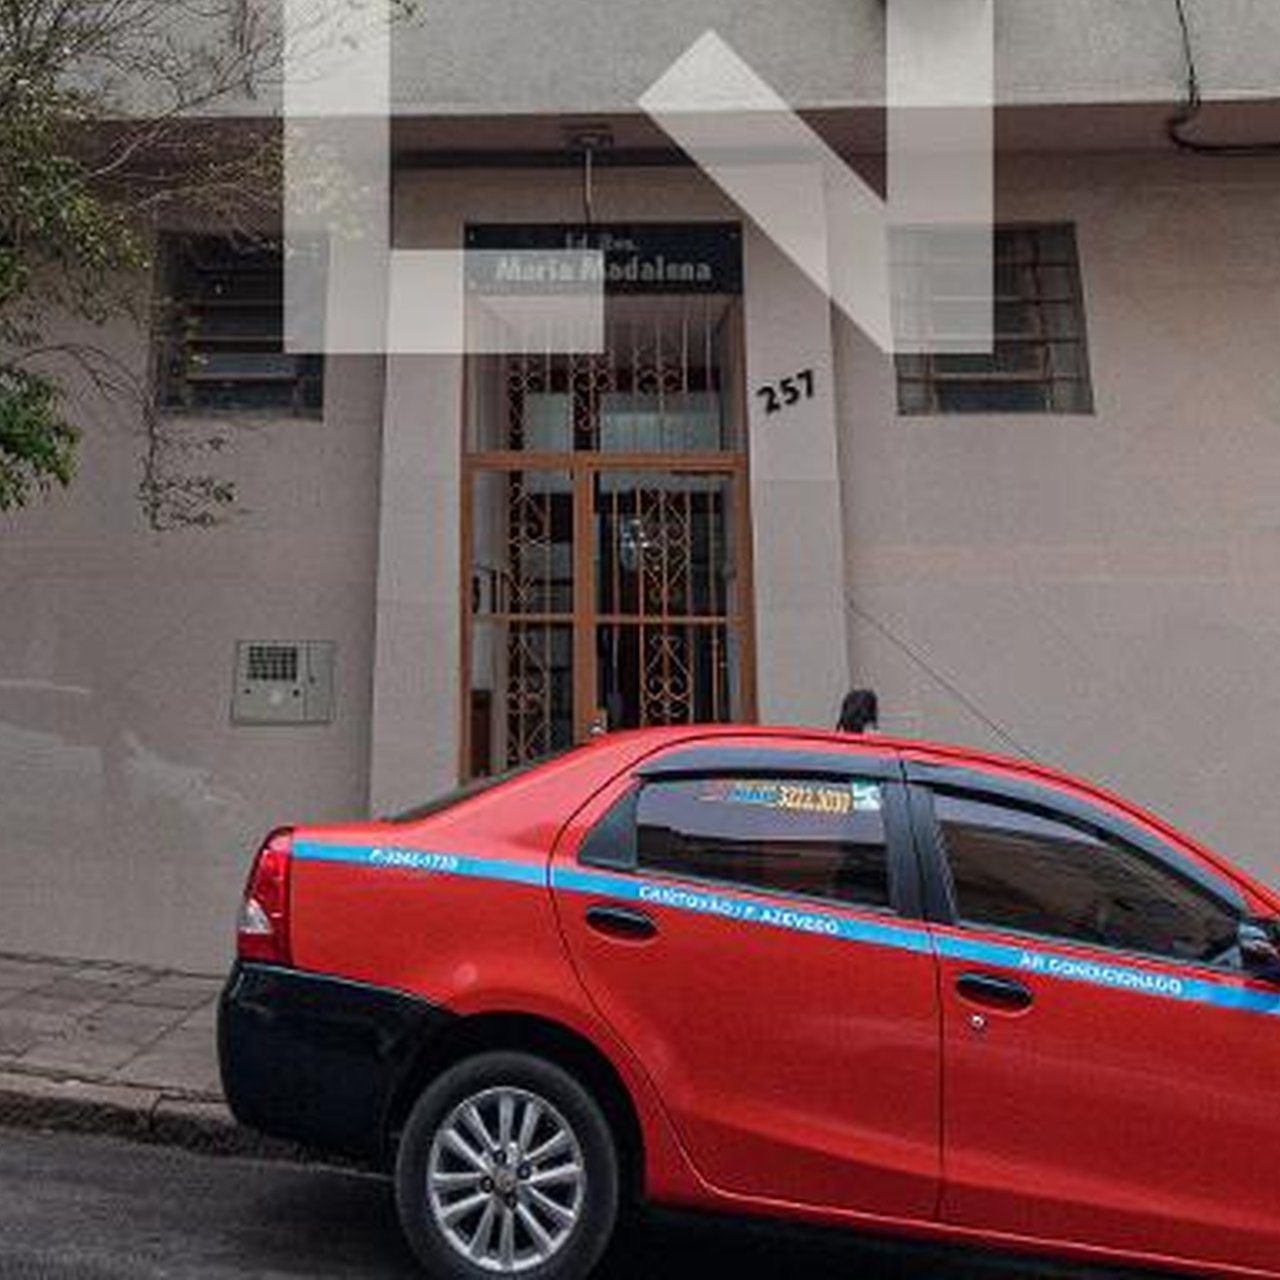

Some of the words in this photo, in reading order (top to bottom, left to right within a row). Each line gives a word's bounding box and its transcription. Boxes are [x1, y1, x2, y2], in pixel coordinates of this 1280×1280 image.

[495, 257, 576, 282] Maria
[581, 256, 712, 282] Madalena
[757, 369, 815, 414] 257
